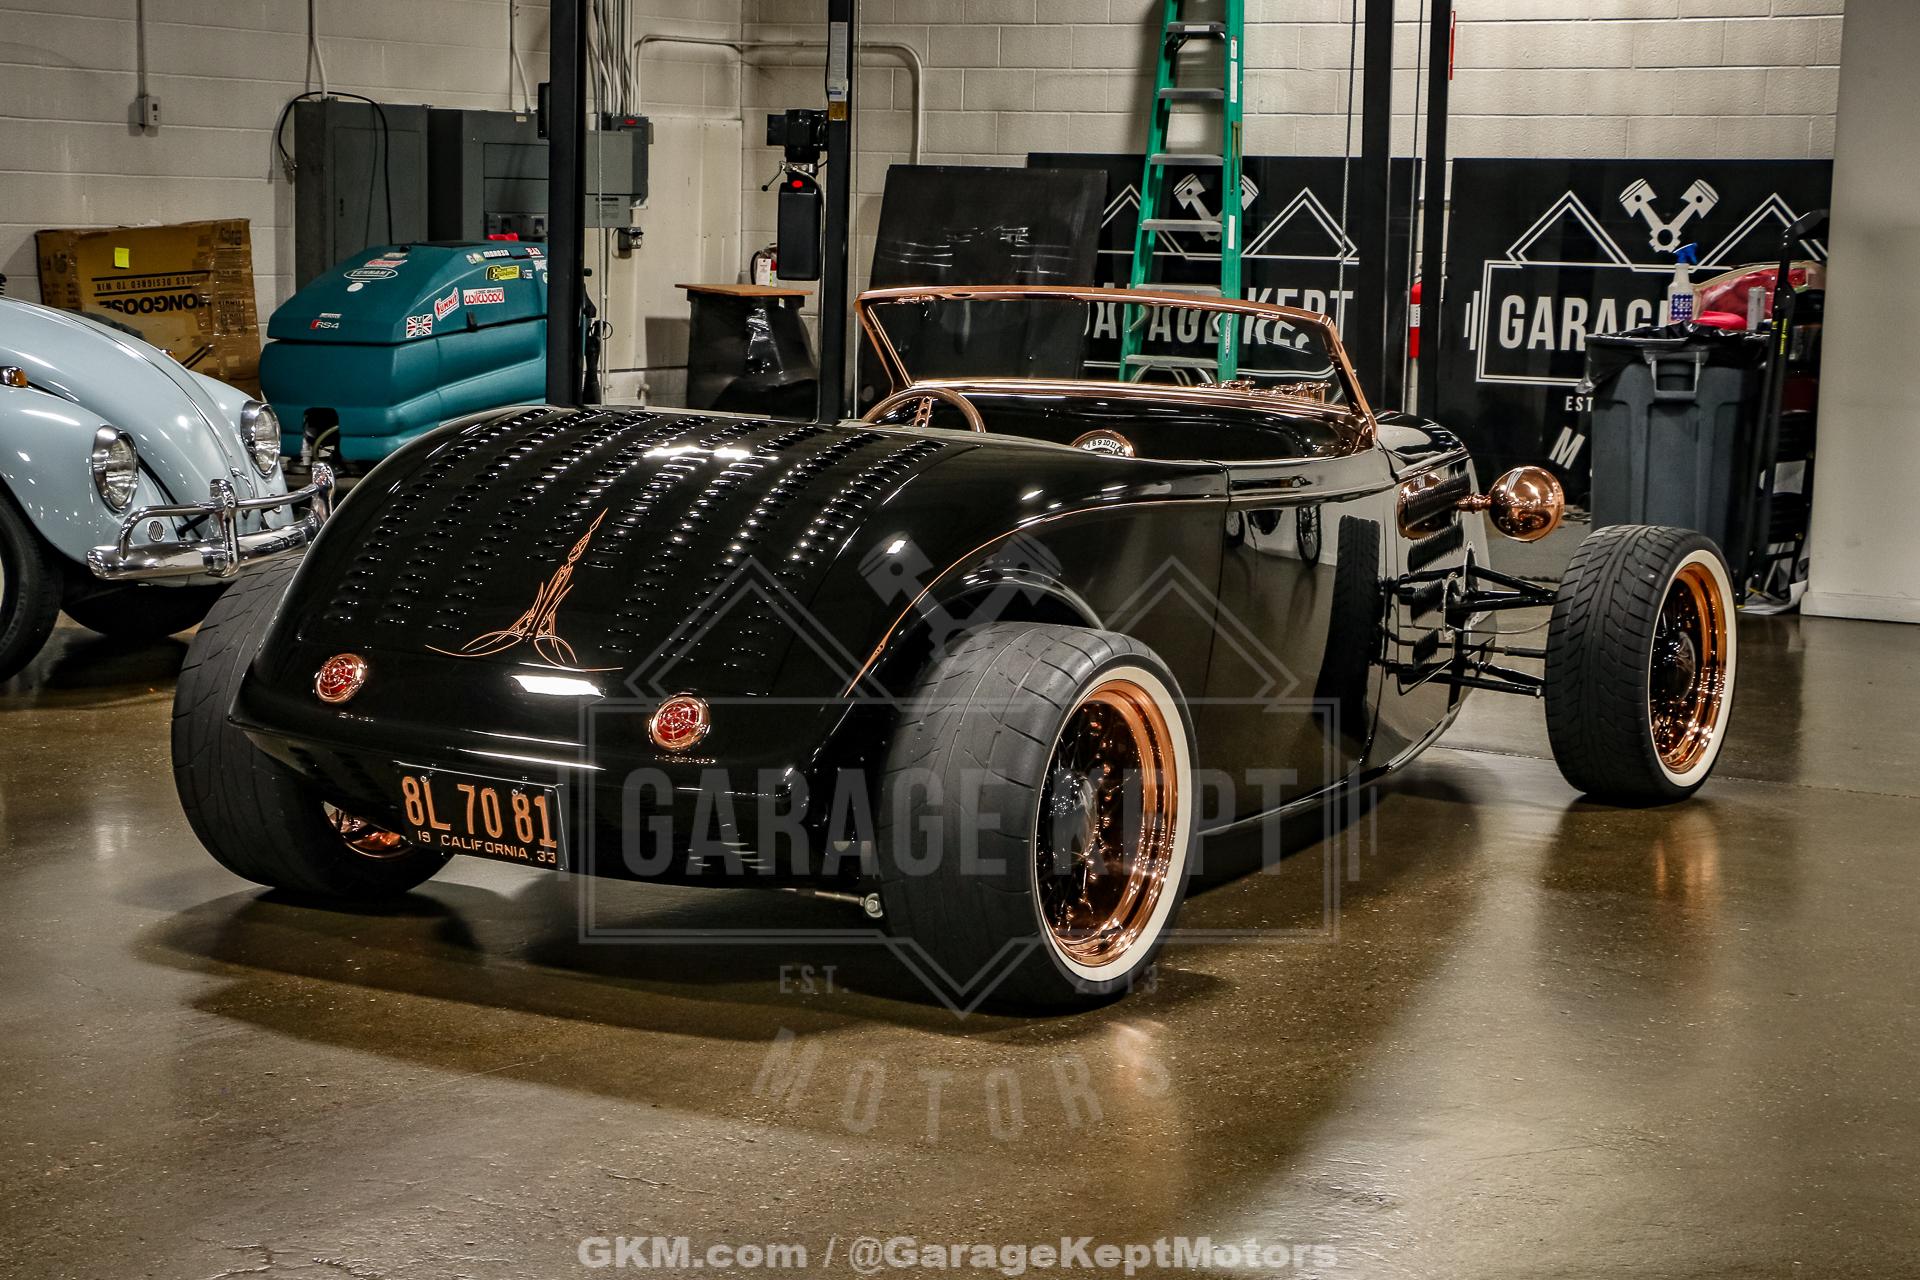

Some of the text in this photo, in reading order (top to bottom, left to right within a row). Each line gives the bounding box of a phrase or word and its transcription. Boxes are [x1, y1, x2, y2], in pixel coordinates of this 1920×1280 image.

[116, 281, 126, 290] TO
[402, 776, 557, 849] 8L 70 81
[440, 834, 528, 859] CALIFORNIA
